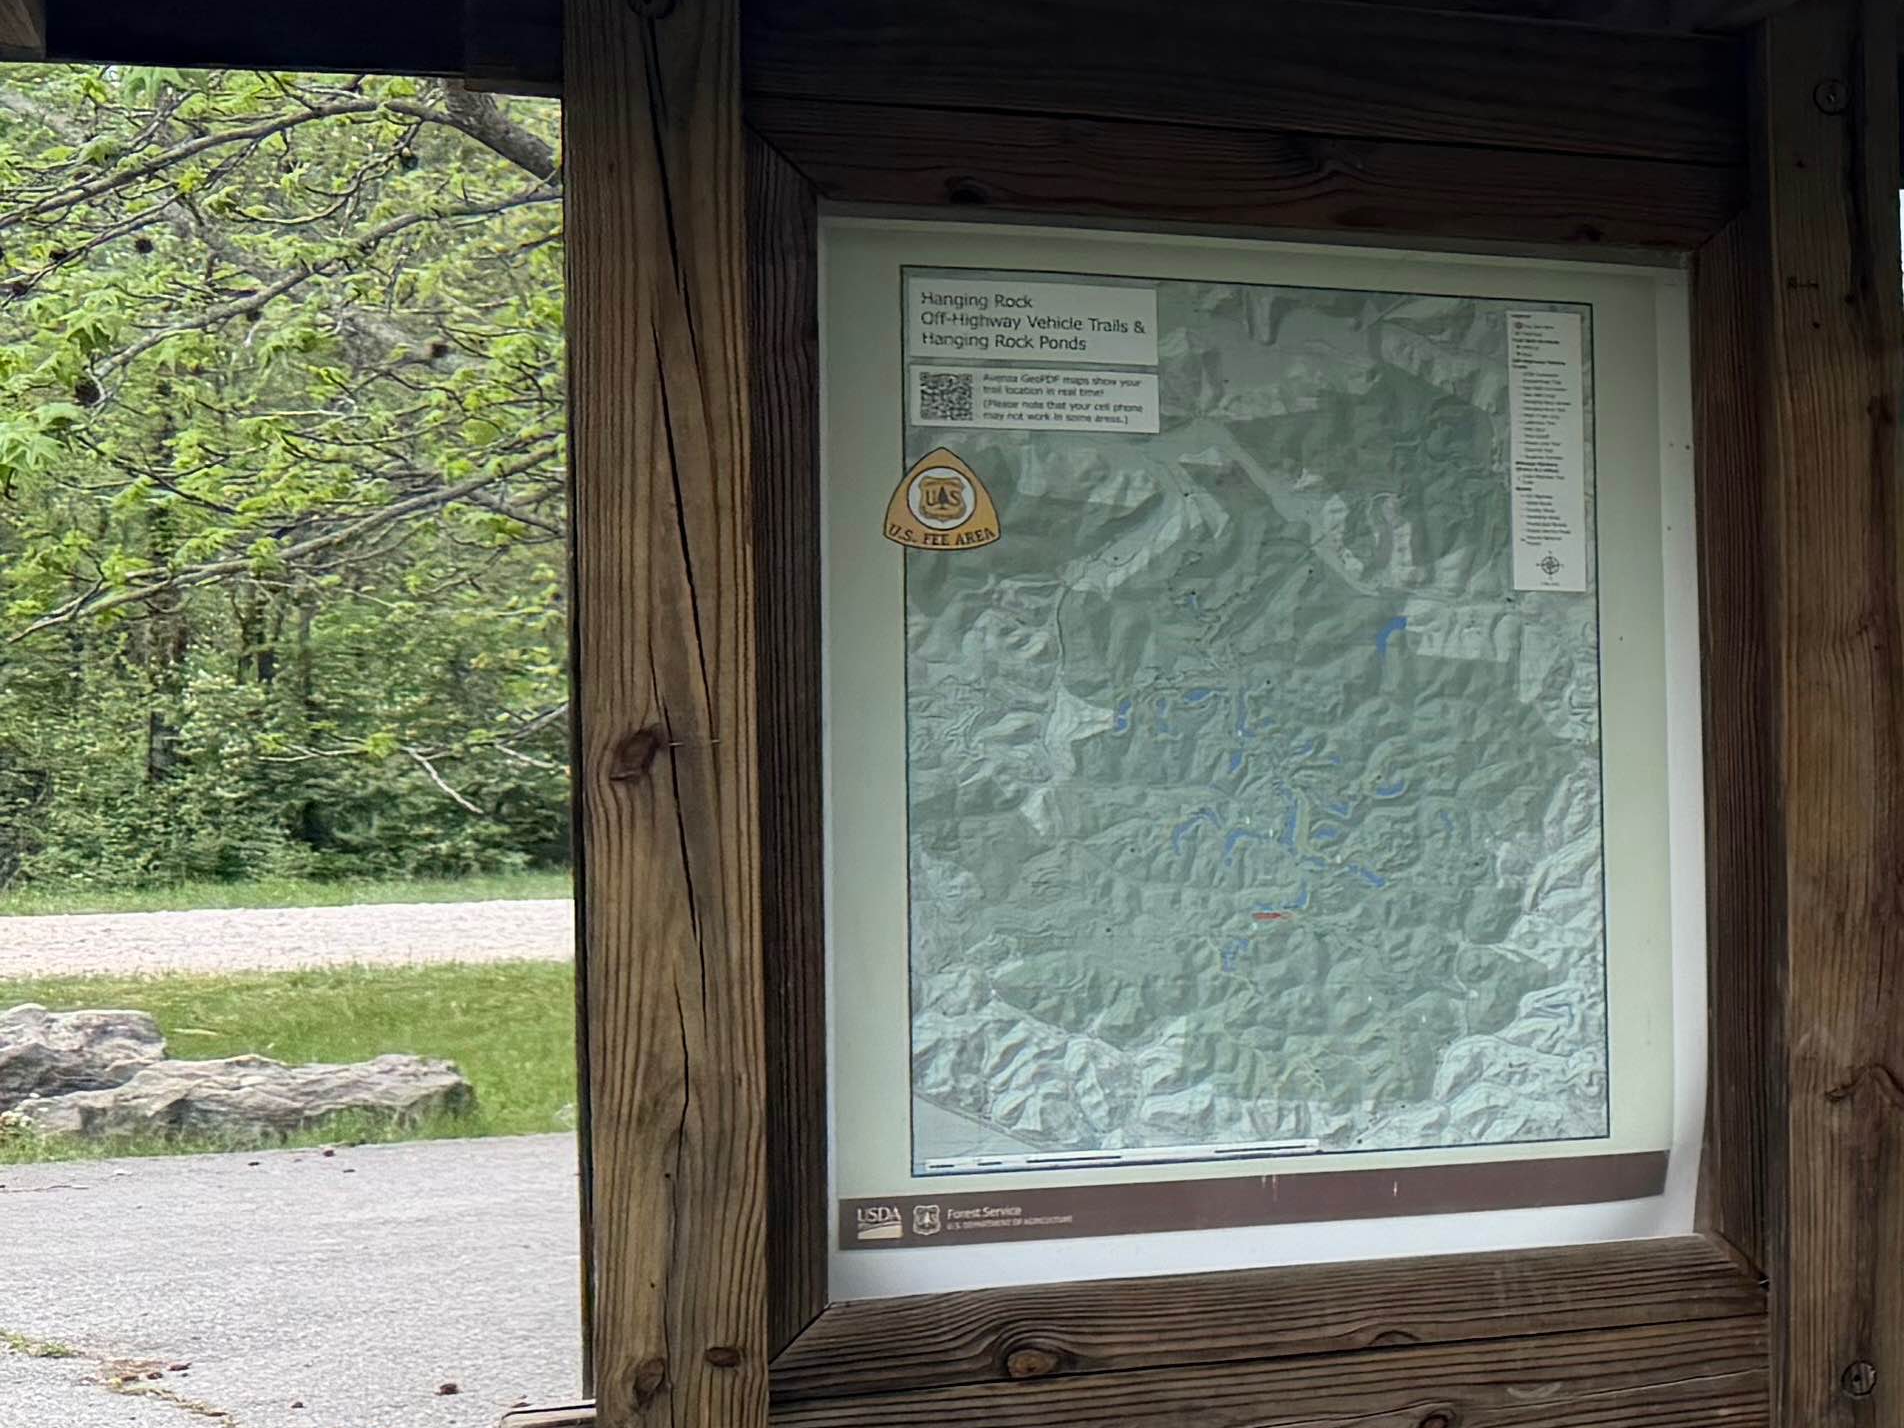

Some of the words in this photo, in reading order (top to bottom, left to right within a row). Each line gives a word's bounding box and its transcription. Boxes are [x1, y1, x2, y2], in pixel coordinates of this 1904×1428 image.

[921, 291, 988, 310] Hanging
[994, 293, 1032, 308] Rock
[921, 311, 1021, 330] Off-Highway
[1027, 315, 1082, 331] Vehicle
[1089, 318, 1128, 333] Trails
[1134, 321, 1146, 334] &
[923, 332, 988, 350] Hanging
[995, 334, 1034, 348] Rock
[1040, 336, 1086, 350] Ponds
[1092, 378, 1116, 386] show
[1120, 380, 1142, 388] your
[1006, 387, 1043, 396] location
[1047, 400, 1066, 409] that
[1070, 403, 1091, 412] your
[1028, 413, 1050, 421] work
[888, 524, 916, 544] U.S.
[924, 532, 950, 546] FEE
[955, 527, 996, 546] AREA
[858, 1207, 901, 1222] USDA
[947, 1207, 981, 1220] Forest
[982, 1206, 1022, 1218] Service
